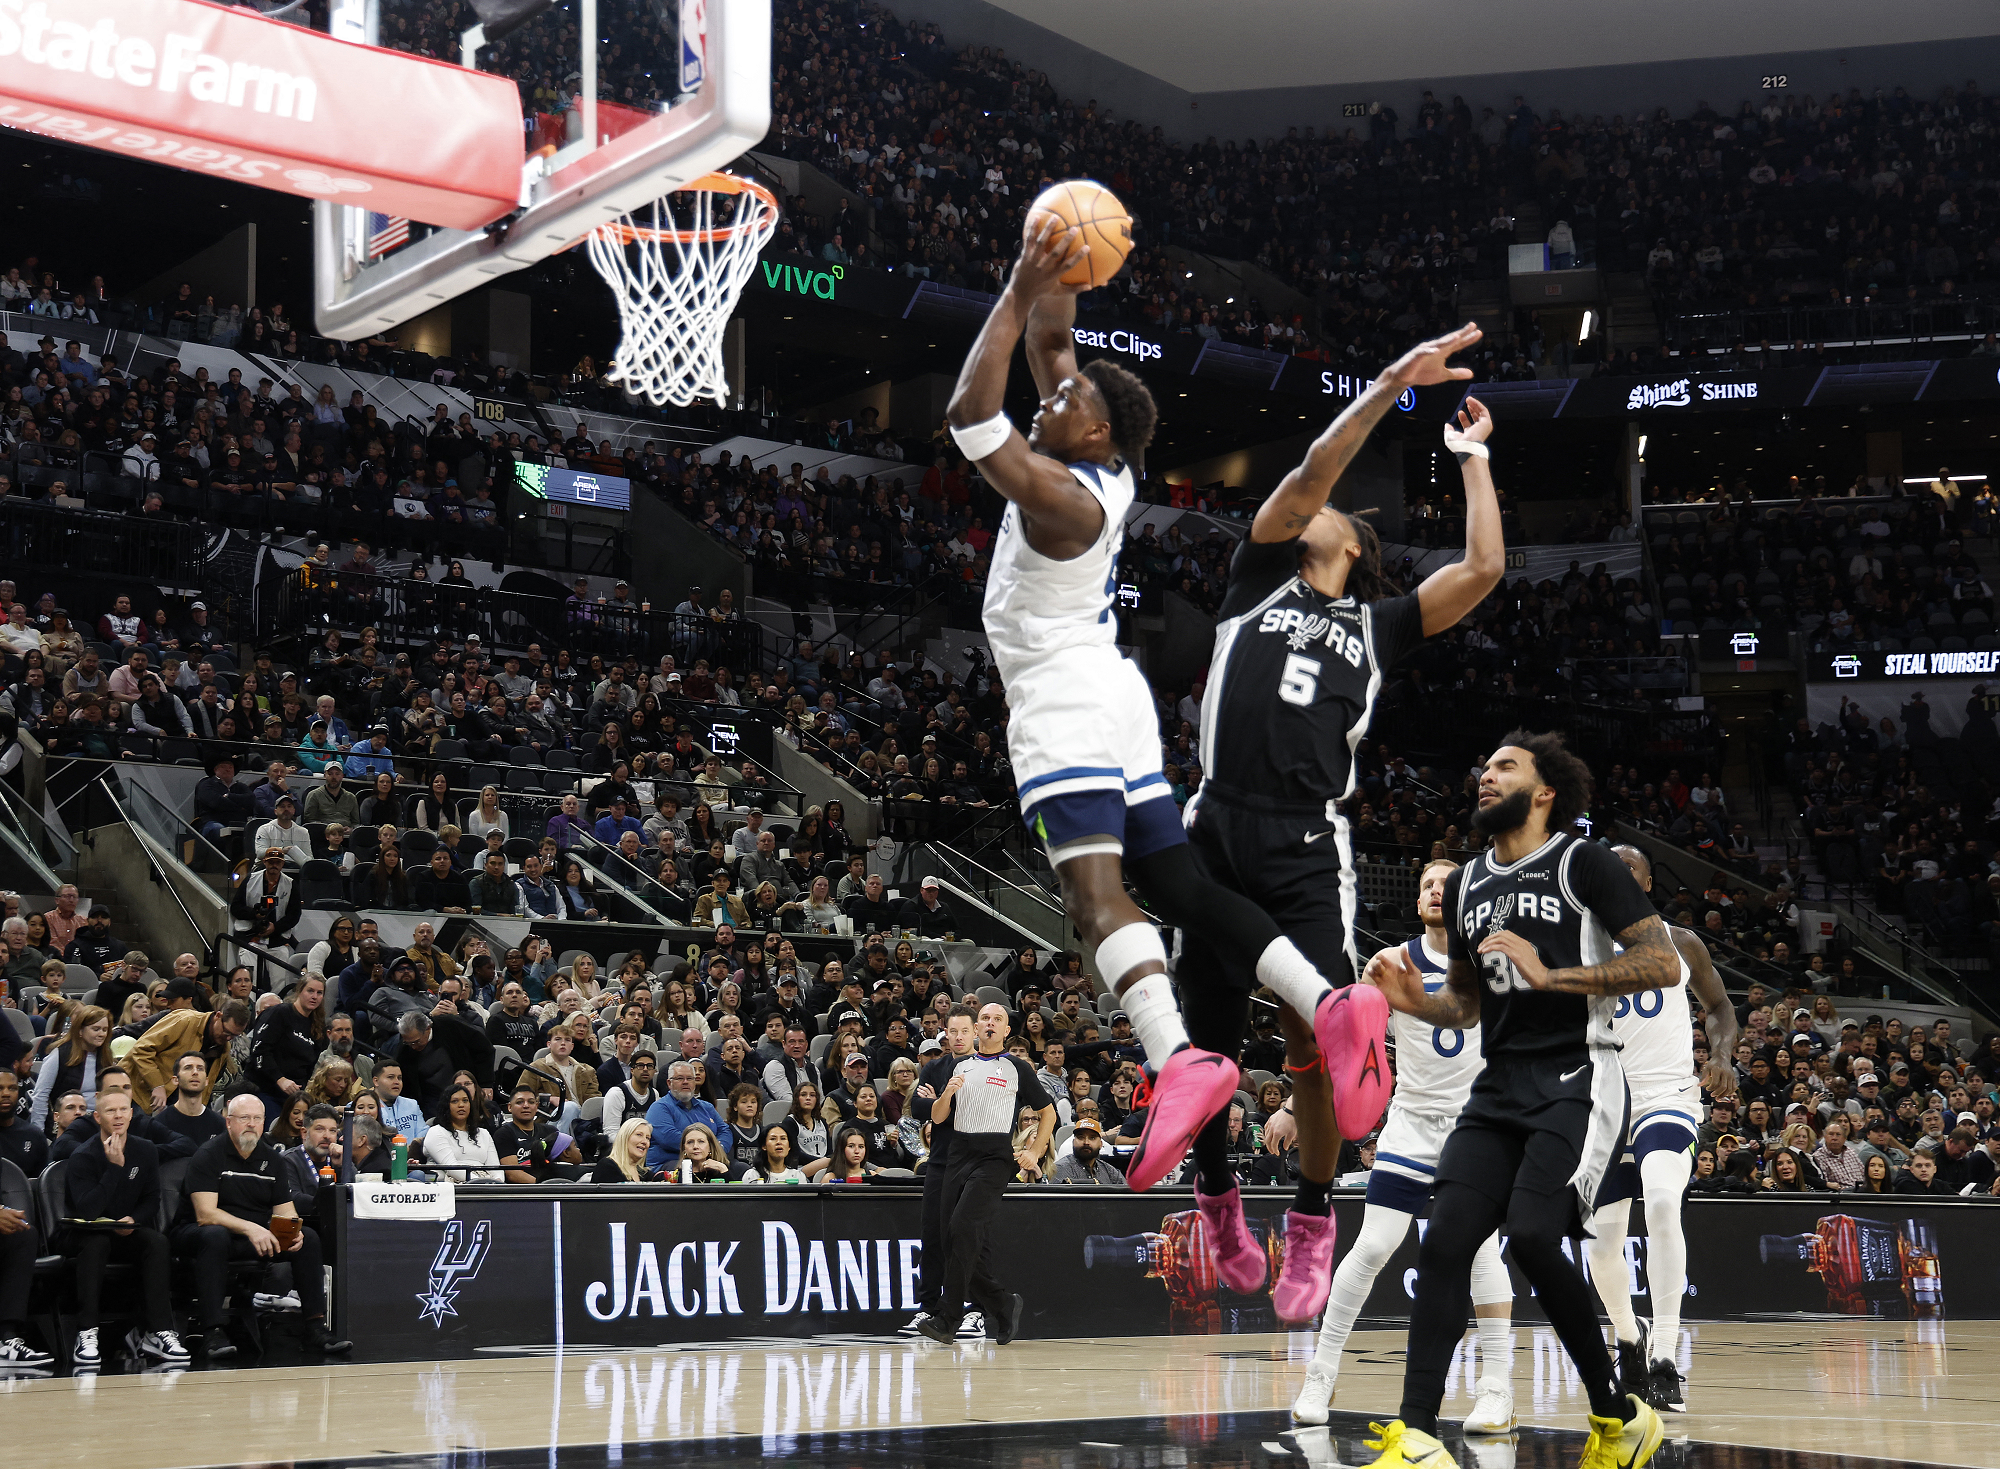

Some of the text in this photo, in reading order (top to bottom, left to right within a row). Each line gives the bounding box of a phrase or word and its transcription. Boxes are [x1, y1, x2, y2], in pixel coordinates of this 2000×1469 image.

[1762, 75, 1787, 88] 212
[1345, 105, 1365, 117] 211
[761, 260, 834, 300] viva
[1069, 326, 1162, 362] eat Clips
[1626, 378, 1691, 411] Shiner
[476, 401, 505, 421] 108
[572, 481, 600, 491] ARENA
[550, 504, 564, 516] EXIT
[1259, 609, 1364, 668] SPURS
[1885, 652, 2000, 675] STEAL YOURSELF
[1278, 654, 1321, 707] 5
[1464, 893, 1561, 939] SPURS
[505, 1022, 535, 1037] SPURS
[1432, 1025, 1465, 1058] 0
[815, 1144, 820, 1155] 1
[370, 1193, 436, 1204] GATORADE
[585, 1220, 923, 1321] JACK DANIE
